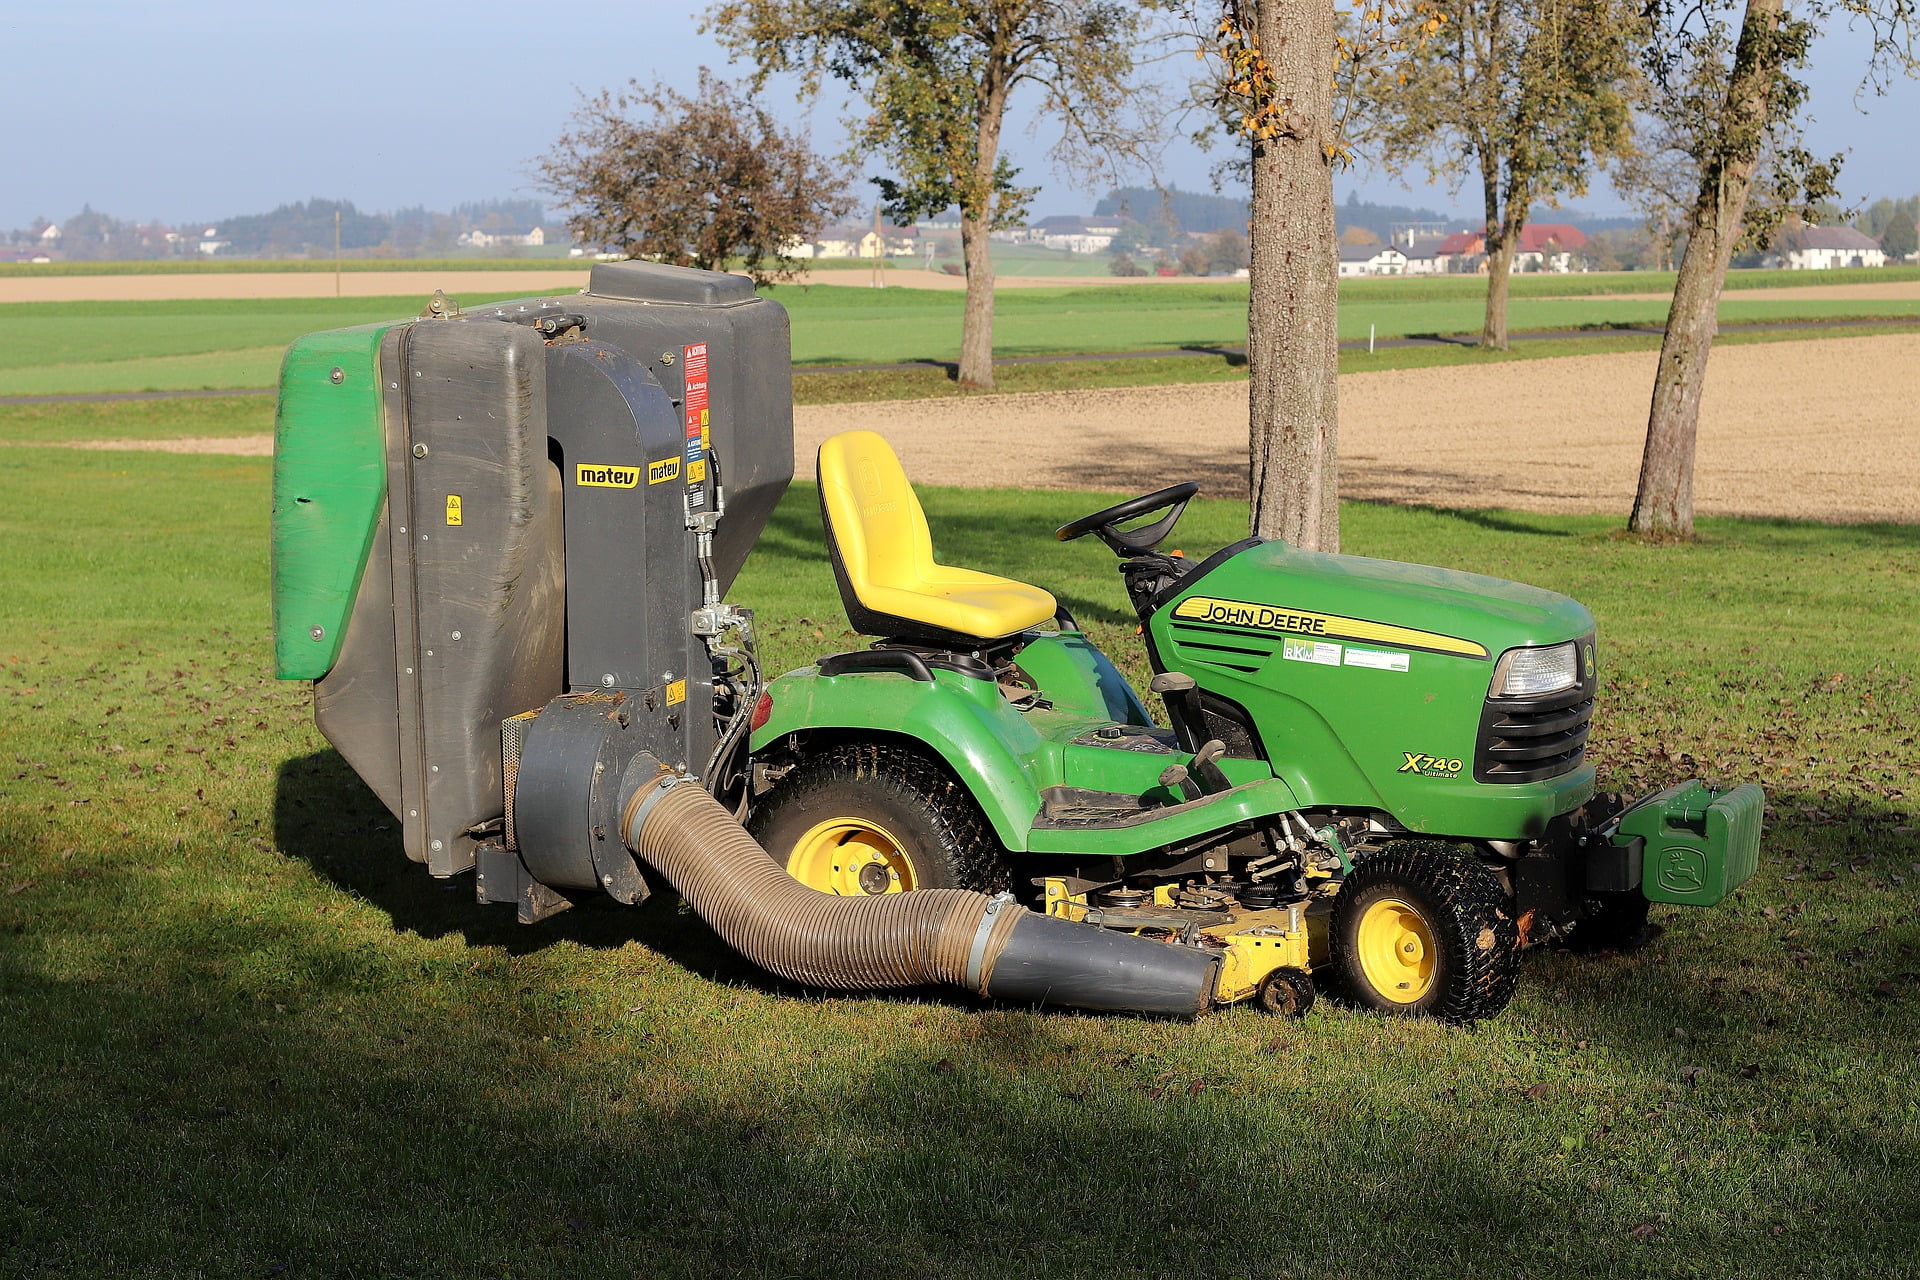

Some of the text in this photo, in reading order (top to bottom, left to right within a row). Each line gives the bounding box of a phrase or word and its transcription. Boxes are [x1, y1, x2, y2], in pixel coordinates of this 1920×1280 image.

[581, 468, 635, 485] matev
[650, 462, 678, 481] matev
[1201, 603, 1326, 633] JOHN DEERE
[1398, 752, 1463, 773] X740
[1424, 770, 1459, 779] Ultimate
